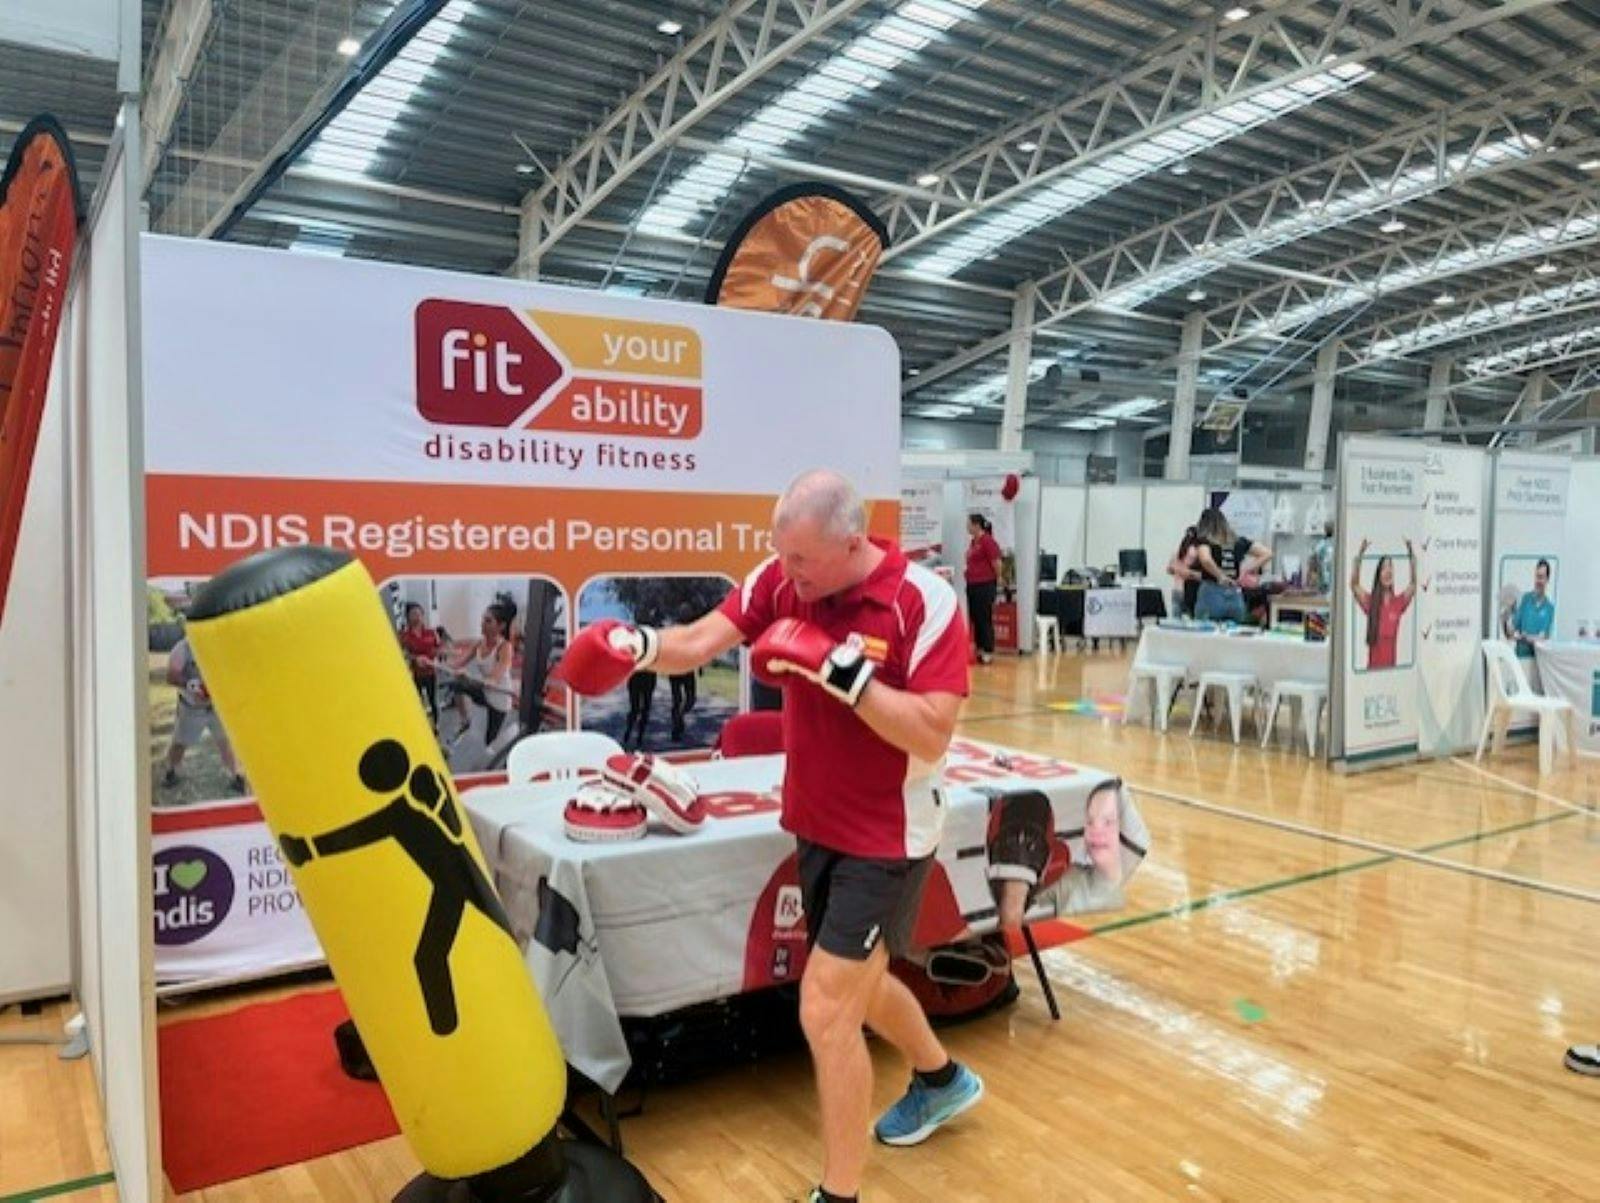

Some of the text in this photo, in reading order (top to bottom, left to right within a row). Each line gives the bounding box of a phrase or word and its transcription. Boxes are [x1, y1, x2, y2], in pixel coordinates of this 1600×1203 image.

[441, 329, 523, 395] fit
[603, 331, 687, 365] your
[571, 386, 689, 434] ability
[425, 435, 696, 471] disability fitness
[178, 512, 309, 549] NDIS
[323, 515, 555, 558] Registered
[566, 519, 722, 552] Personal
[154, 864, 170, 895] I
[248, 868, 294, 890] NDI
[154, 896, 215, 930] ndis
